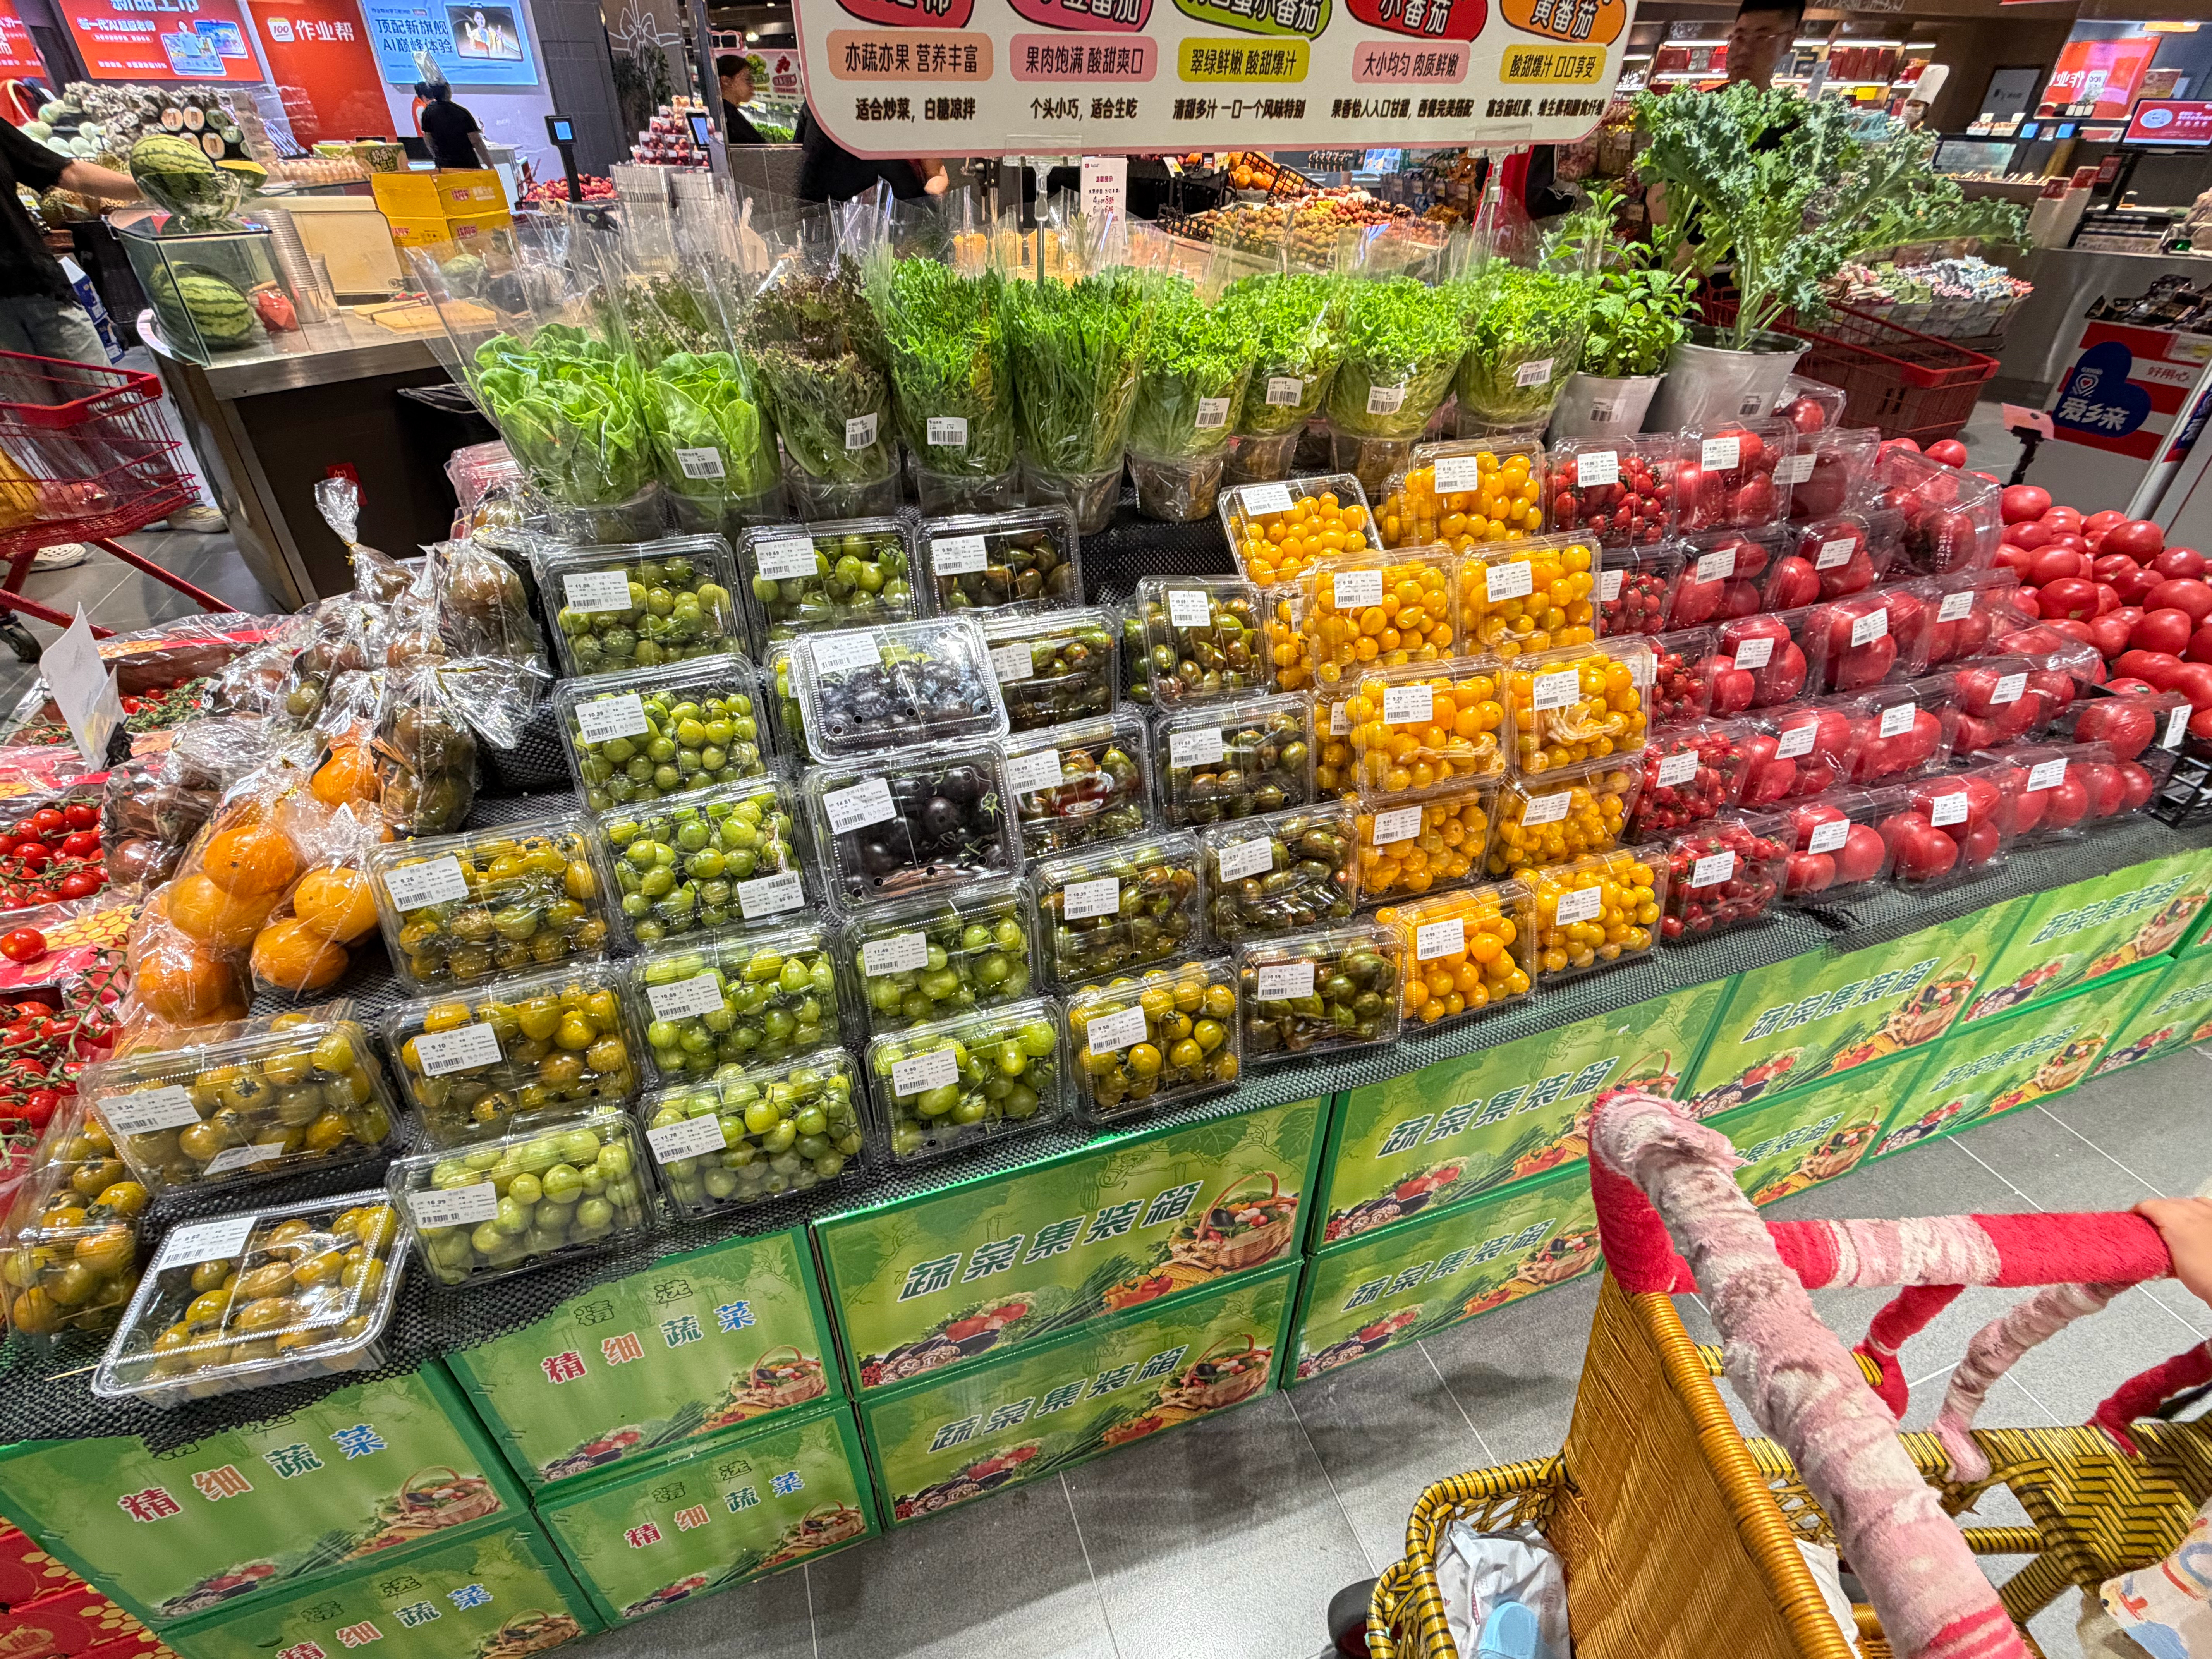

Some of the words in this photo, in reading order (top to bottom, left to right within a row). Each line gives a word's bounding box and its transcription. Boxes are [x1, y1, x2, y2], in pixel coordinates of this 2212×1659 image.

[295, 19, 355, 42] 作业帮
[375, 19, 449, 35] 顶配新旗舰
[845, 42, 910, 72] 亦蔬亦果
[916, 43, 978, 74] 营养丰富
[1025, 46, 1084, 74] 果肉饱满
[1087, 46, 1144, 74] 酸甜爽口
[1190, 49, 1242, 76] 翠绿鲜嫩
[1245, 50, 1297, 76] 酸甜爆汁
[1362, 51, 1410, 77] 大小均匀
[1412, 52, 1460, 77] 肉质鲜嫩
[1509, 54, 1553, 77] 酸甜爆汁
[1554, 56, 1597, 78] 口口享受
[2027, 872, 2193, 947] 蔬菜集装箱
[1739, 957, 1940, 1044] 蔬菜集装箱
[1929, 1022, 2083, 1093] 蔬菜集装箱
[1374, 1055, 1620, 1159] 蔬菜集装箱
[1735, 1111, 1846, 1169] 集装箱
[896, 1179, 1206, 1303] 蔬菜集装箱
[1340, 1218, 1556, 1312] 蔬菜集装箱
[541, 1299, 757, 1385] 精细蔬菜
[926, 1344, 1190, 1455] 蔬菜集装箱
[117, 1423, 388, 1523] 精细蔬菜
[624, 1470, 805, 1549] 精细蔬菜
